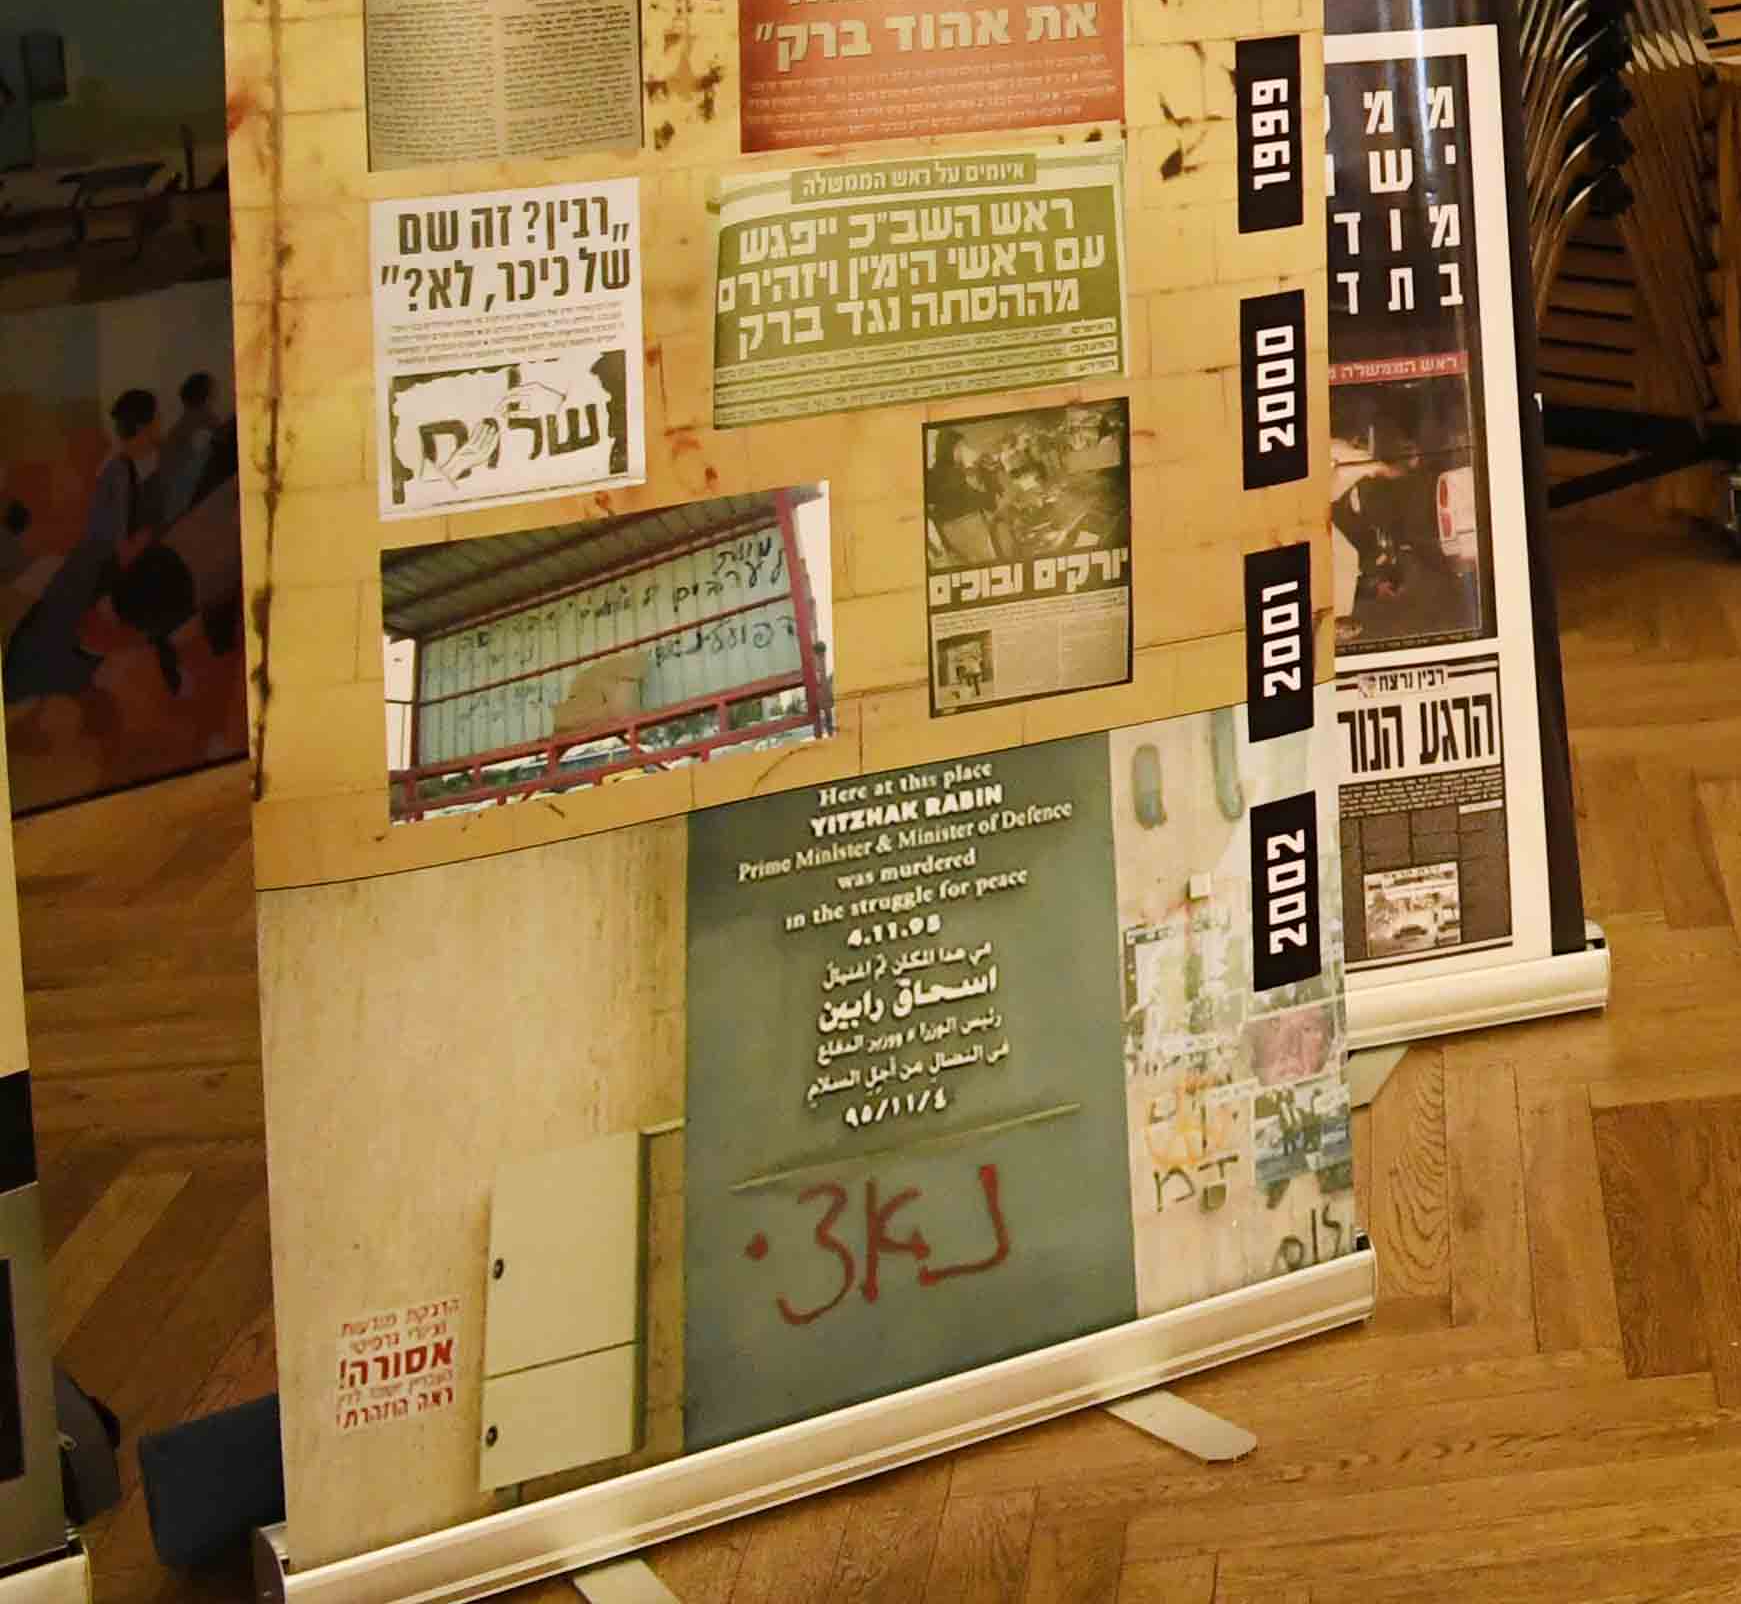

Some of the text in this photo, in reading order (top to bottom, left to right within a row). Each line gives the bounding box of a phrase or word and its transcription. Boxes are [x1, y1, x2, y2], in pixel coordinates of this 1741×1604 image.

[887, 3, 1098, 52] את אהוד
[1252, 79, 1291, 190] 1999
[399, 205, 512, 255] זה שם
[739, 198, 1074, 265] ראש ייפגש
[579, 247, 631, 294] של
[849, 235, 1105, 297] עם ראשי הימין
[737, 277, 1079, 360] מההסתה נגד ברק
[1256, 325, 1295, 452] 2000
[1262, 581, 1301, 697] 2001
[1419, 693, 1494, 765] הרגע
[810, 785, 1002, 838] YITZHAK RABIN
[819, 761, 992, 807] Here at this place
[738, 859, 792, 883] Prime
[795, 840, 872, 874] Minister
[899, 822, 974, 852] Minister
[977, 812, 1000, 835] of
[1002, 801, 1073, 830] Defence
[837, 848, 976, 890] was murdered
[813, 902, 844, 925] the
[851, 887, 931, 917] struggle
[939, 878, 969, 899] for
[975, 868, 1029, 898] peace
[1267, 829, 1307, 954] 2002
